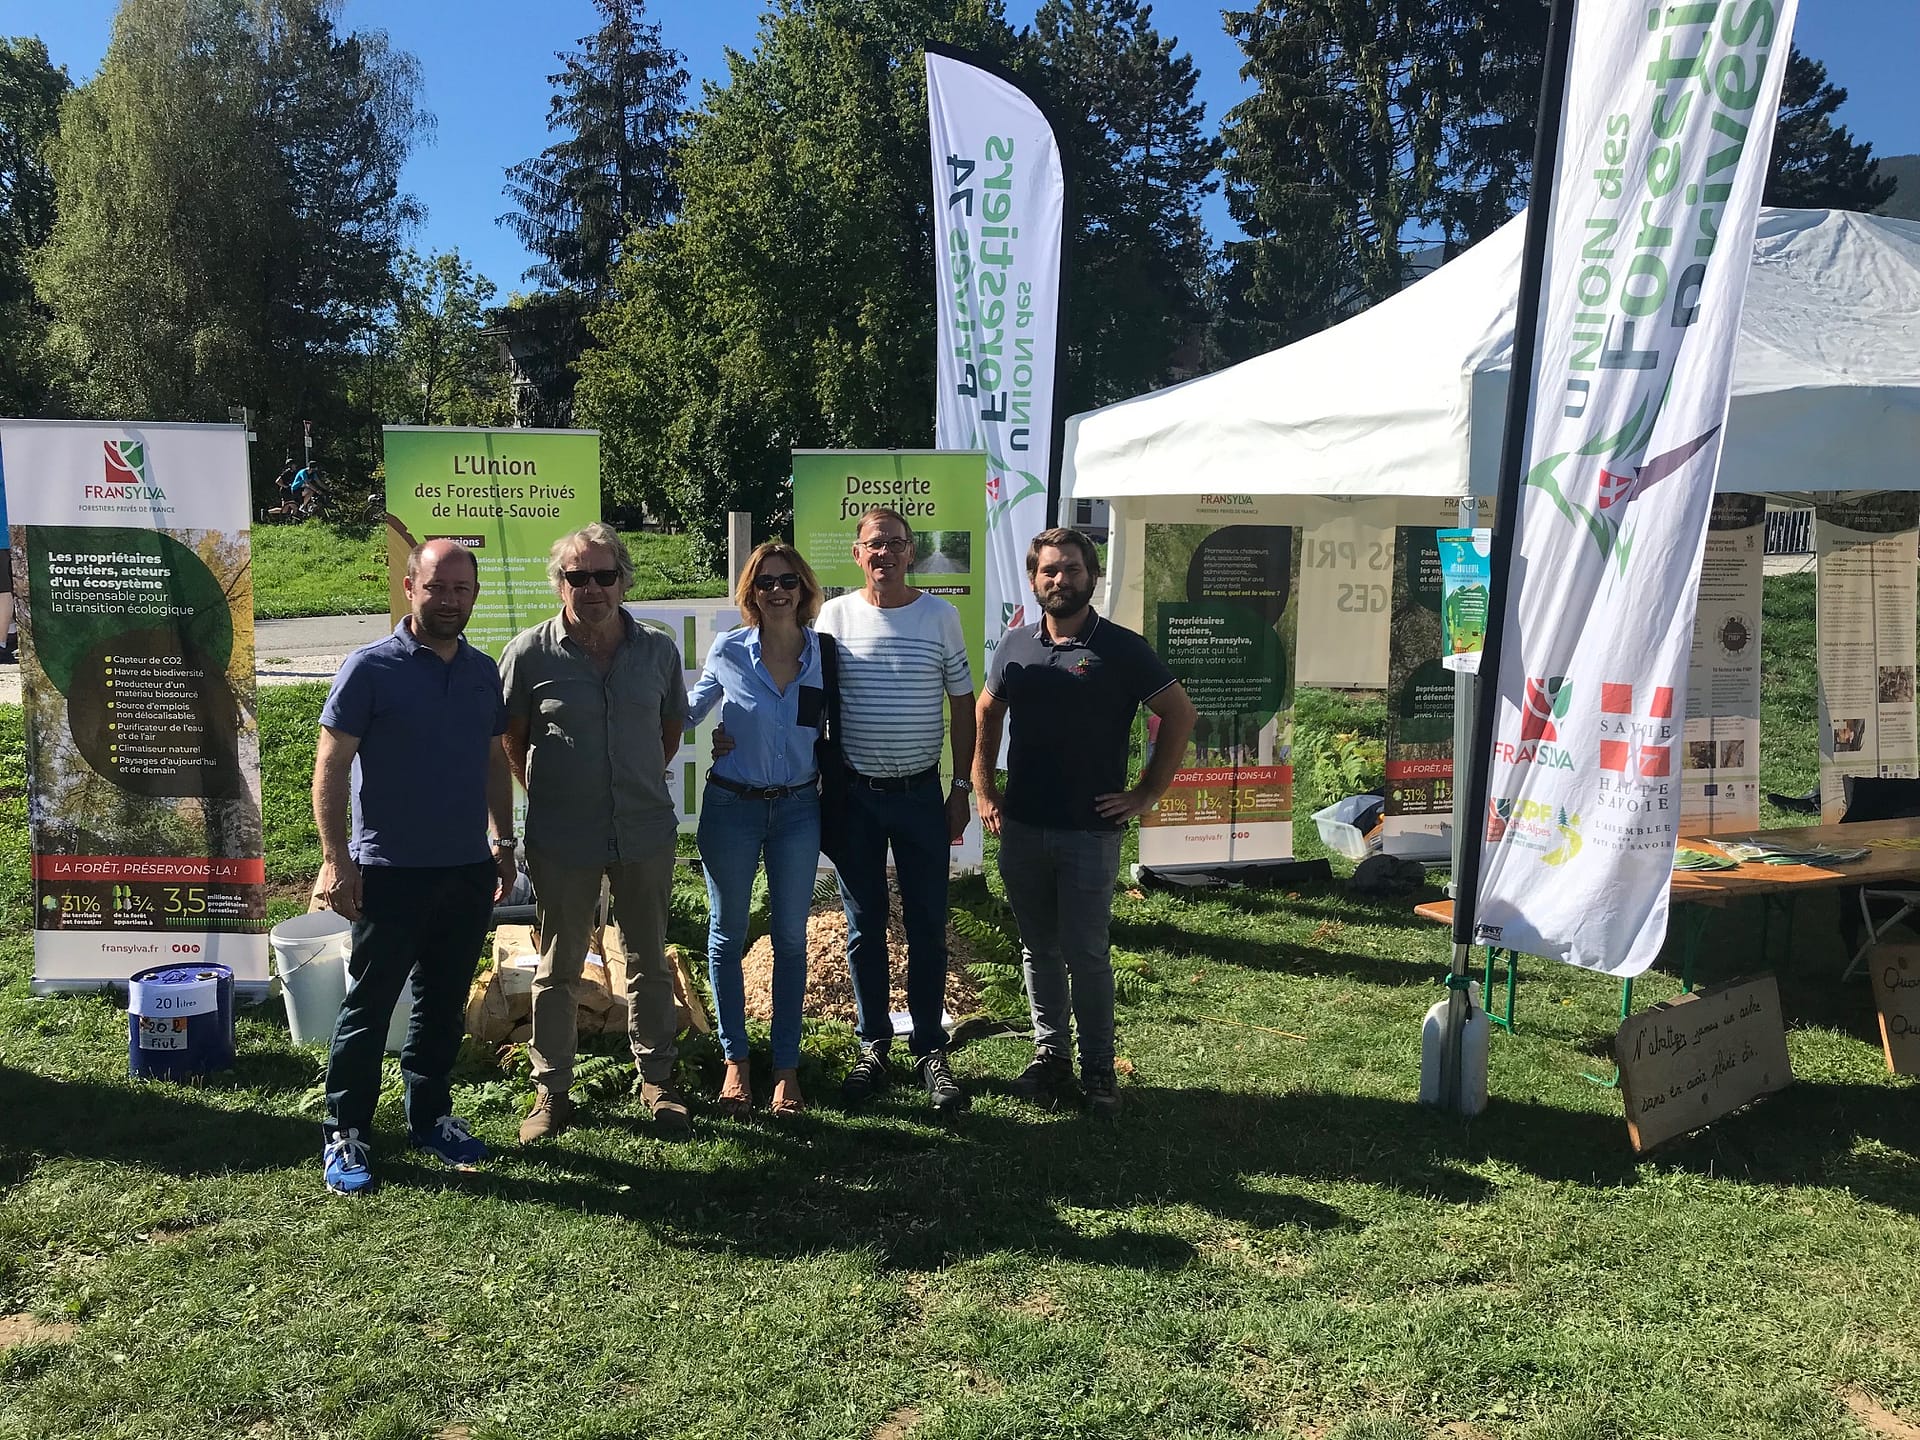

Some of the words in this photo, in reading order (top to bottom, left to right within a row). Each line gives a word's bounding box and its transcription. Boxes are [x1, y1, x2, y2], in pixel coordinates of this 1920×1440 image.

[1594, 112, 1630, 200] des
[1599, 2, 1718, 370] Foresti
[847, 476, 930, 494] Desserte
[85, 485, 166, 500] FRANSYLVA
[415, 483, 441, 498] des
[447, 484, 524, 498] Forestiers
[530, 484, 575, 499] Privés
[1201, 494, 1253, 504] FRANSYLVA
[116, 505, 137, 513] PRIVÉS
[432, 503, 451, 517] de
[457, 503, 560, 518] Haute-Savoie
[48, 552, 72, 562] Les
[75, 552, 161, 565] propriétaires
[48, 564, 118, 577] forestiers,
[121, 567, 171, 577] acteurs
[50, 577, 80, 587] d'un
[83, 577, 163, 590] écosystème
[51, 590, 136, 602] indispensable
[139, 593, 168, 603] pour
[52, 602, 63, 612] la
[66, 603, 124, 613] transition
[127, 604, 194, 616] écologique
[1169, 616, 1224, 626] Propriétaires
[1168, 626, 1212, 635] forestiers,
[1168, 636, 1208, 646] rejoignez
[1210, 636, 1252, 646] Fransylva,
[1177, 647, 1210, 656] syndicat
[1211, 647, 1224, 655] qui
[113, 656, 147, 664] Capteur
[114, 668, 138, 676] Havre
[140, 668, 151, 676] de
[153, 669, 204, 677] biodiversité
[115, 680, 162, 688] Producteur
[115, 690, 153, 698] matériau
[155, 690, 199, 698] biosourcé
[1415, 686, 1455, 694] Représente
[146, 703, 190, 711] d'emplois
[134, 712, 196, 720] délocalisables
[117, 723, 167, 731] Purificateur
[183, 724, 203, 732] l'eau
[1600, 720, 1671, 738] SAVOIE
[119, 744, 167, 753] Climatiseur
[169, 745, 200, 753] naturel
[119, 756, 158, 765] Paysages
[160, 757, 217, 766] d'aujourd'hui
[142, 766, 176, 774] demain
[1205, 771, 1272, 781] SOUTENONS-LA
[1404, 789, 1426, 801] 31%
[1160, 798, 1187, 811] 31%
[1597, 793, 1669, 812] SAVOIE
[54, 863, 71, 873] LA
[75, 862, 120, 874] FORÊT,
[123, 862, 231, 876] PRÉSERVONS-LA
[61, 895, 101, 912] 31%
[163, 888, 206, 916] 3,5
[101, 944, 159, 954] fransylva.fr
[156, 998, 172, 1009] 20
[149, 1022, 167, 1033] 20
